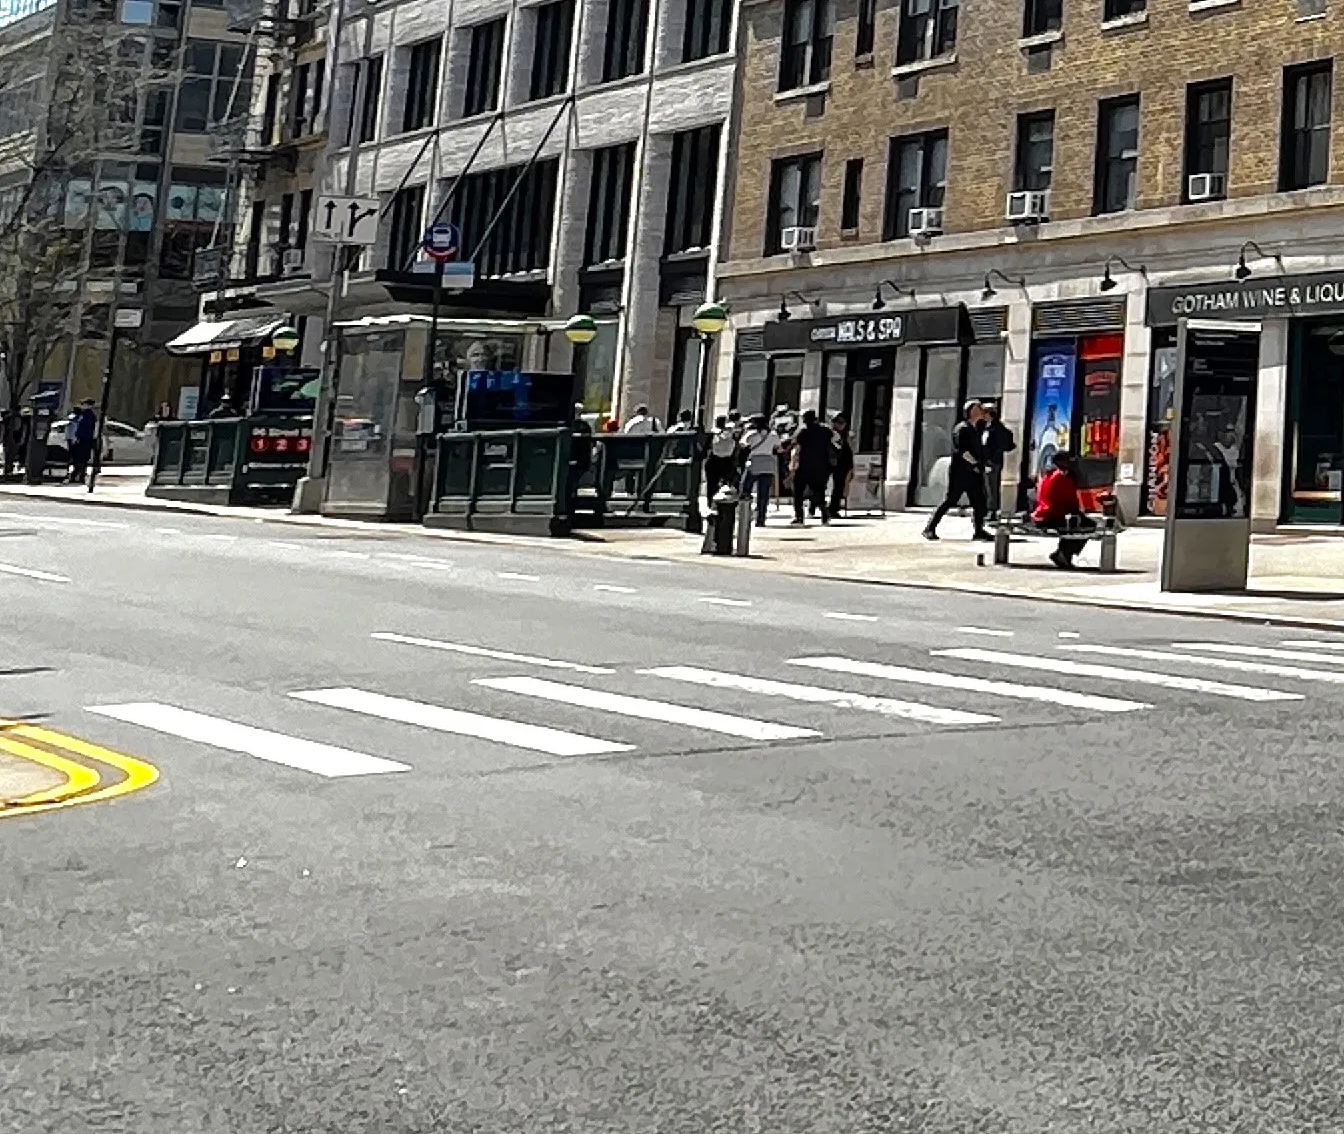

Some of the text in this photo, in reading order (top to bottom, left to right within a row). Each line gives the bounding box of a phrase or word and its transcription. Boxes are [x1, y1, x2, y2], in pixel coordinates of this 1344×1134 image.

[1172, 291, 1239, 313] GOTHAM
[1243, 287, 1287, 308] WINE
[1289, 287, 1300, 304] &
[878, 317, 902, 340] SPA
[276, 438, 287, 451] 2
